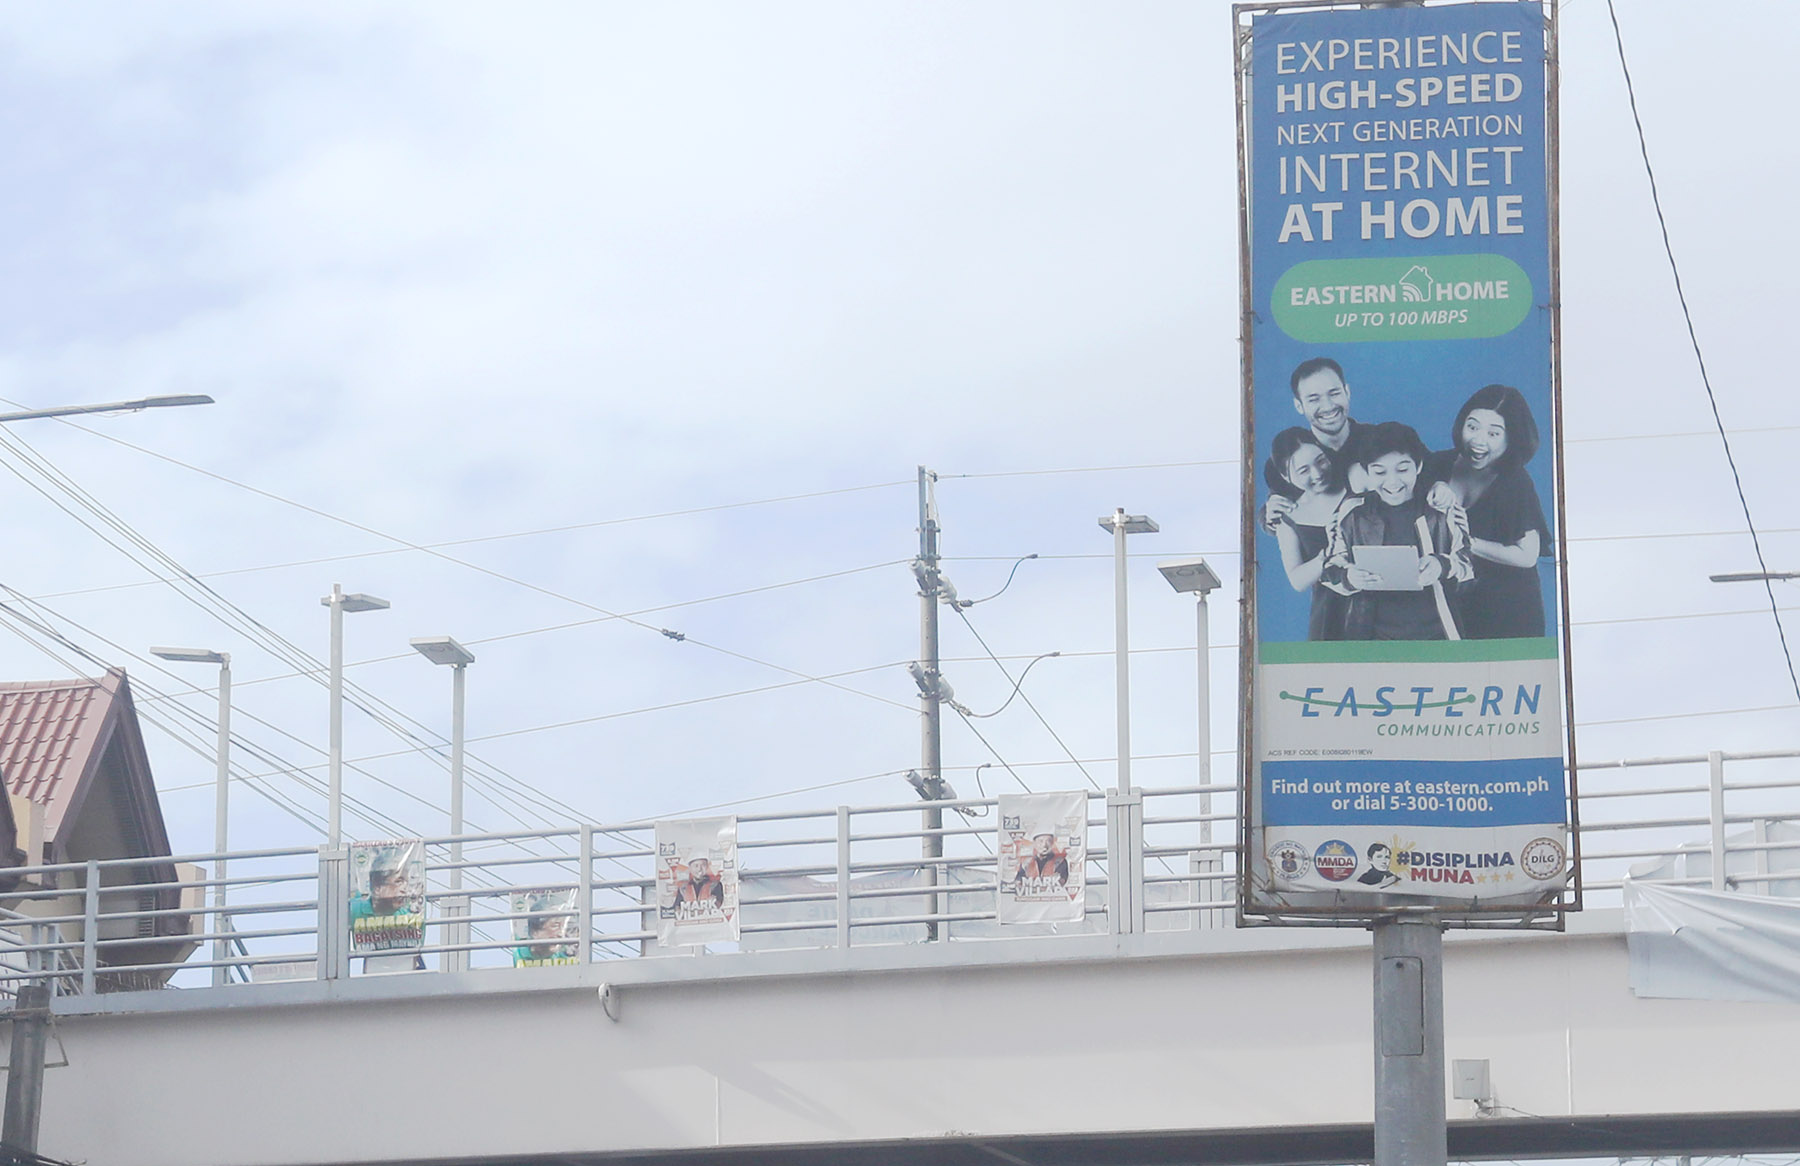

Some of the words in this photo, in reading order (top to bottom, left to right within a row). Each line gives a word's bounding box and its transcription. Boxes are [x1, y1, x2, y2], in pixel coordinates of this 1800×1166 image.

[1276, 31, 1523, 74] EXPERIENCE
[1276, 73, 1523, 113] HIGH-SPEED
[1277, 121, 1345, 146] NEXT
[1352, 115, 1523, 142] GENERATION
[1279, 146, 1524, 195] INTERNET
[1278, 202, 1343, 243] AT
[1361, 195, 1524, 240] HOME
[1290, 284, 1396, 307] EASTERN
[1435, 281, 1509, 301] HOME
[1335, 313, 1358, 328] UP
[1361, 312, 1384, 327] TO
[1388, 311, 1418, 326] 100
[1421, 309, 1468, 325] MBPS
[1301, 683, 1541, 718] EASTERN
[1376, 721, 1541, 737] COMMUNICATIONS
[1271, 779, 1308, 794] Find
[1313, 780, 1342, 794] out
[1346, 782, 1390, 794] more
[1394, 780, 1411, 794] at
[1415, 776, 1549, 798] eastern.com.ph
[1332, 799, 1350, 811] or
[1354, 797, 1385, 811] dial
[1390, 797, 1494, 812] 5-300-1000.
[1317, 856, 1354, 868] MMDA
[1396, 851, 1514, 868] #DISIPLINA
[1531, 854, 1555, 865] DILG
[1022, 876, 1061, 888] MARK
[1411, 868, 1475, 884] MUNA
[680, 898, 717, 911] MARK
